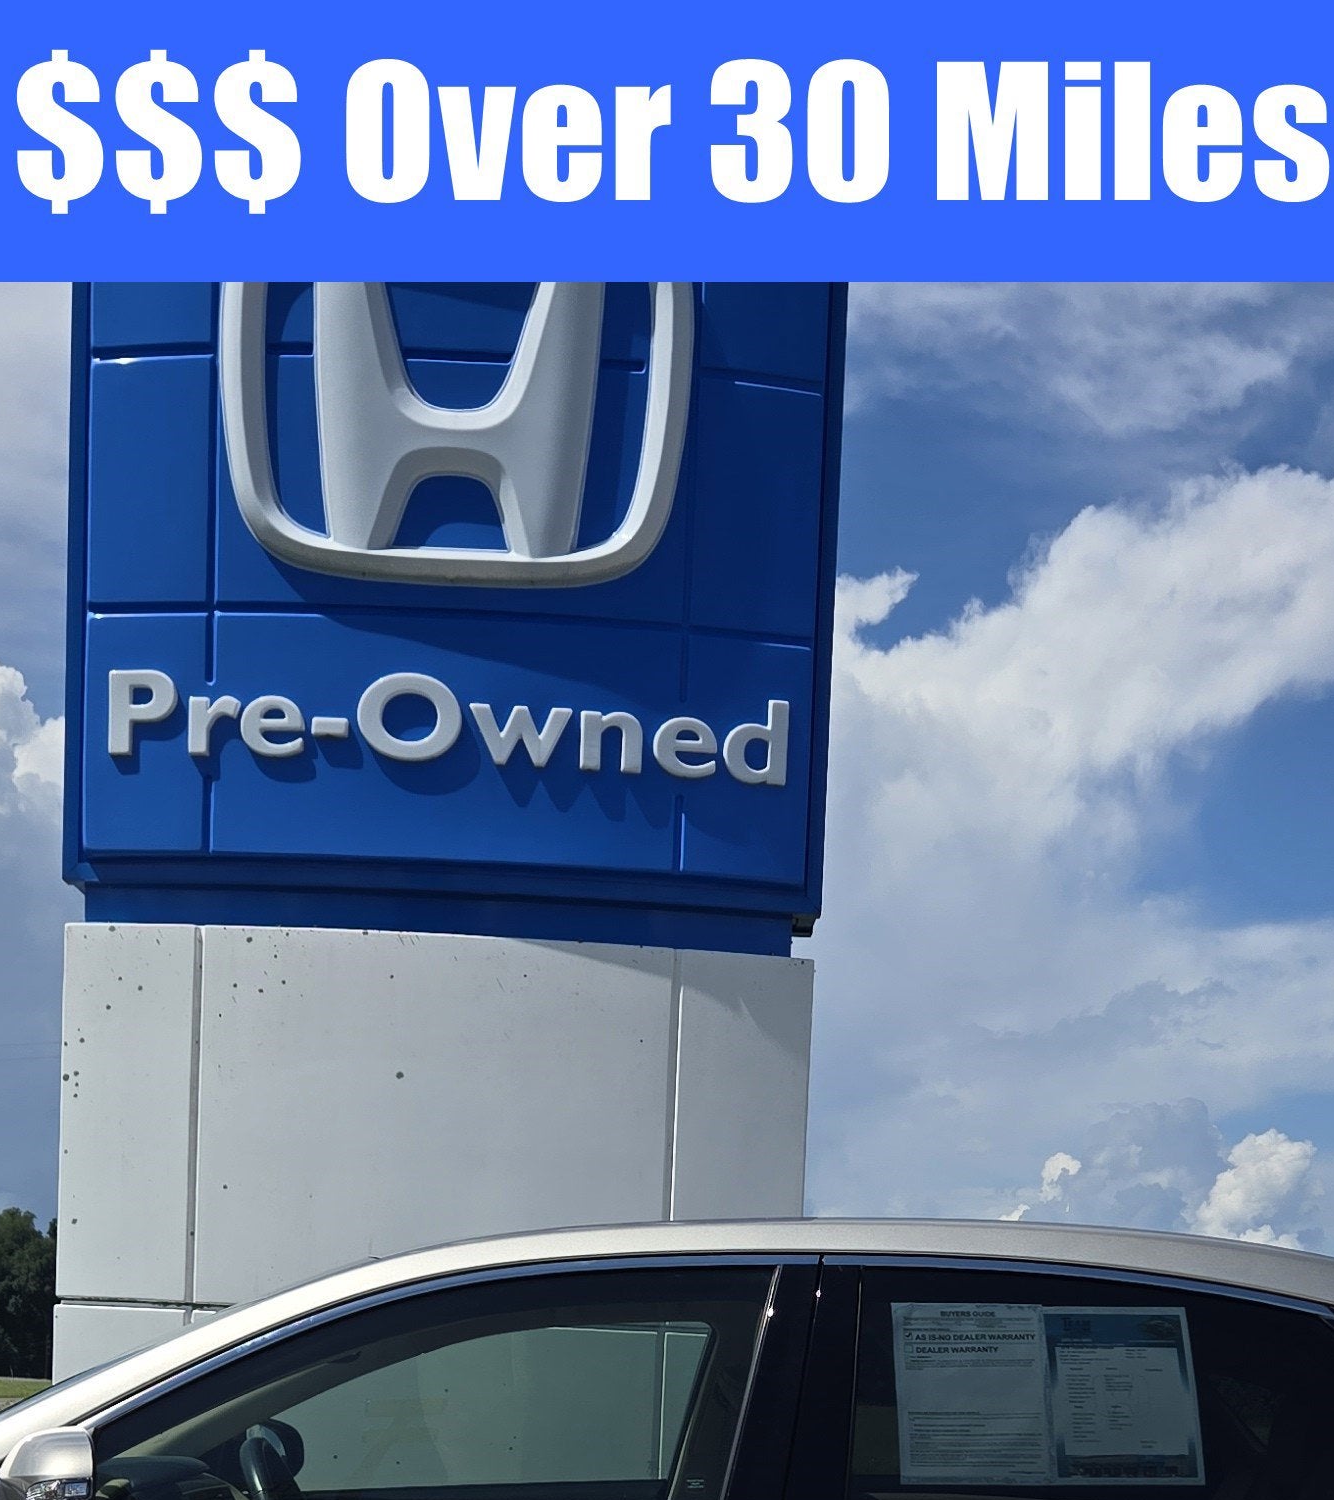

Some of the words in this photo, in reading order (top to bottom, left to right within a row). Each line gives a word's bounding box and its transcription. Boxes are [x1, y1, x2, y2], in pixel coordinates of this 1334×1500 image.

[106, 667, 792, 788] Pre-Owned
[915, 1333, 927, 1341] AS
[916, 1346, 949, 1354] DEALER
